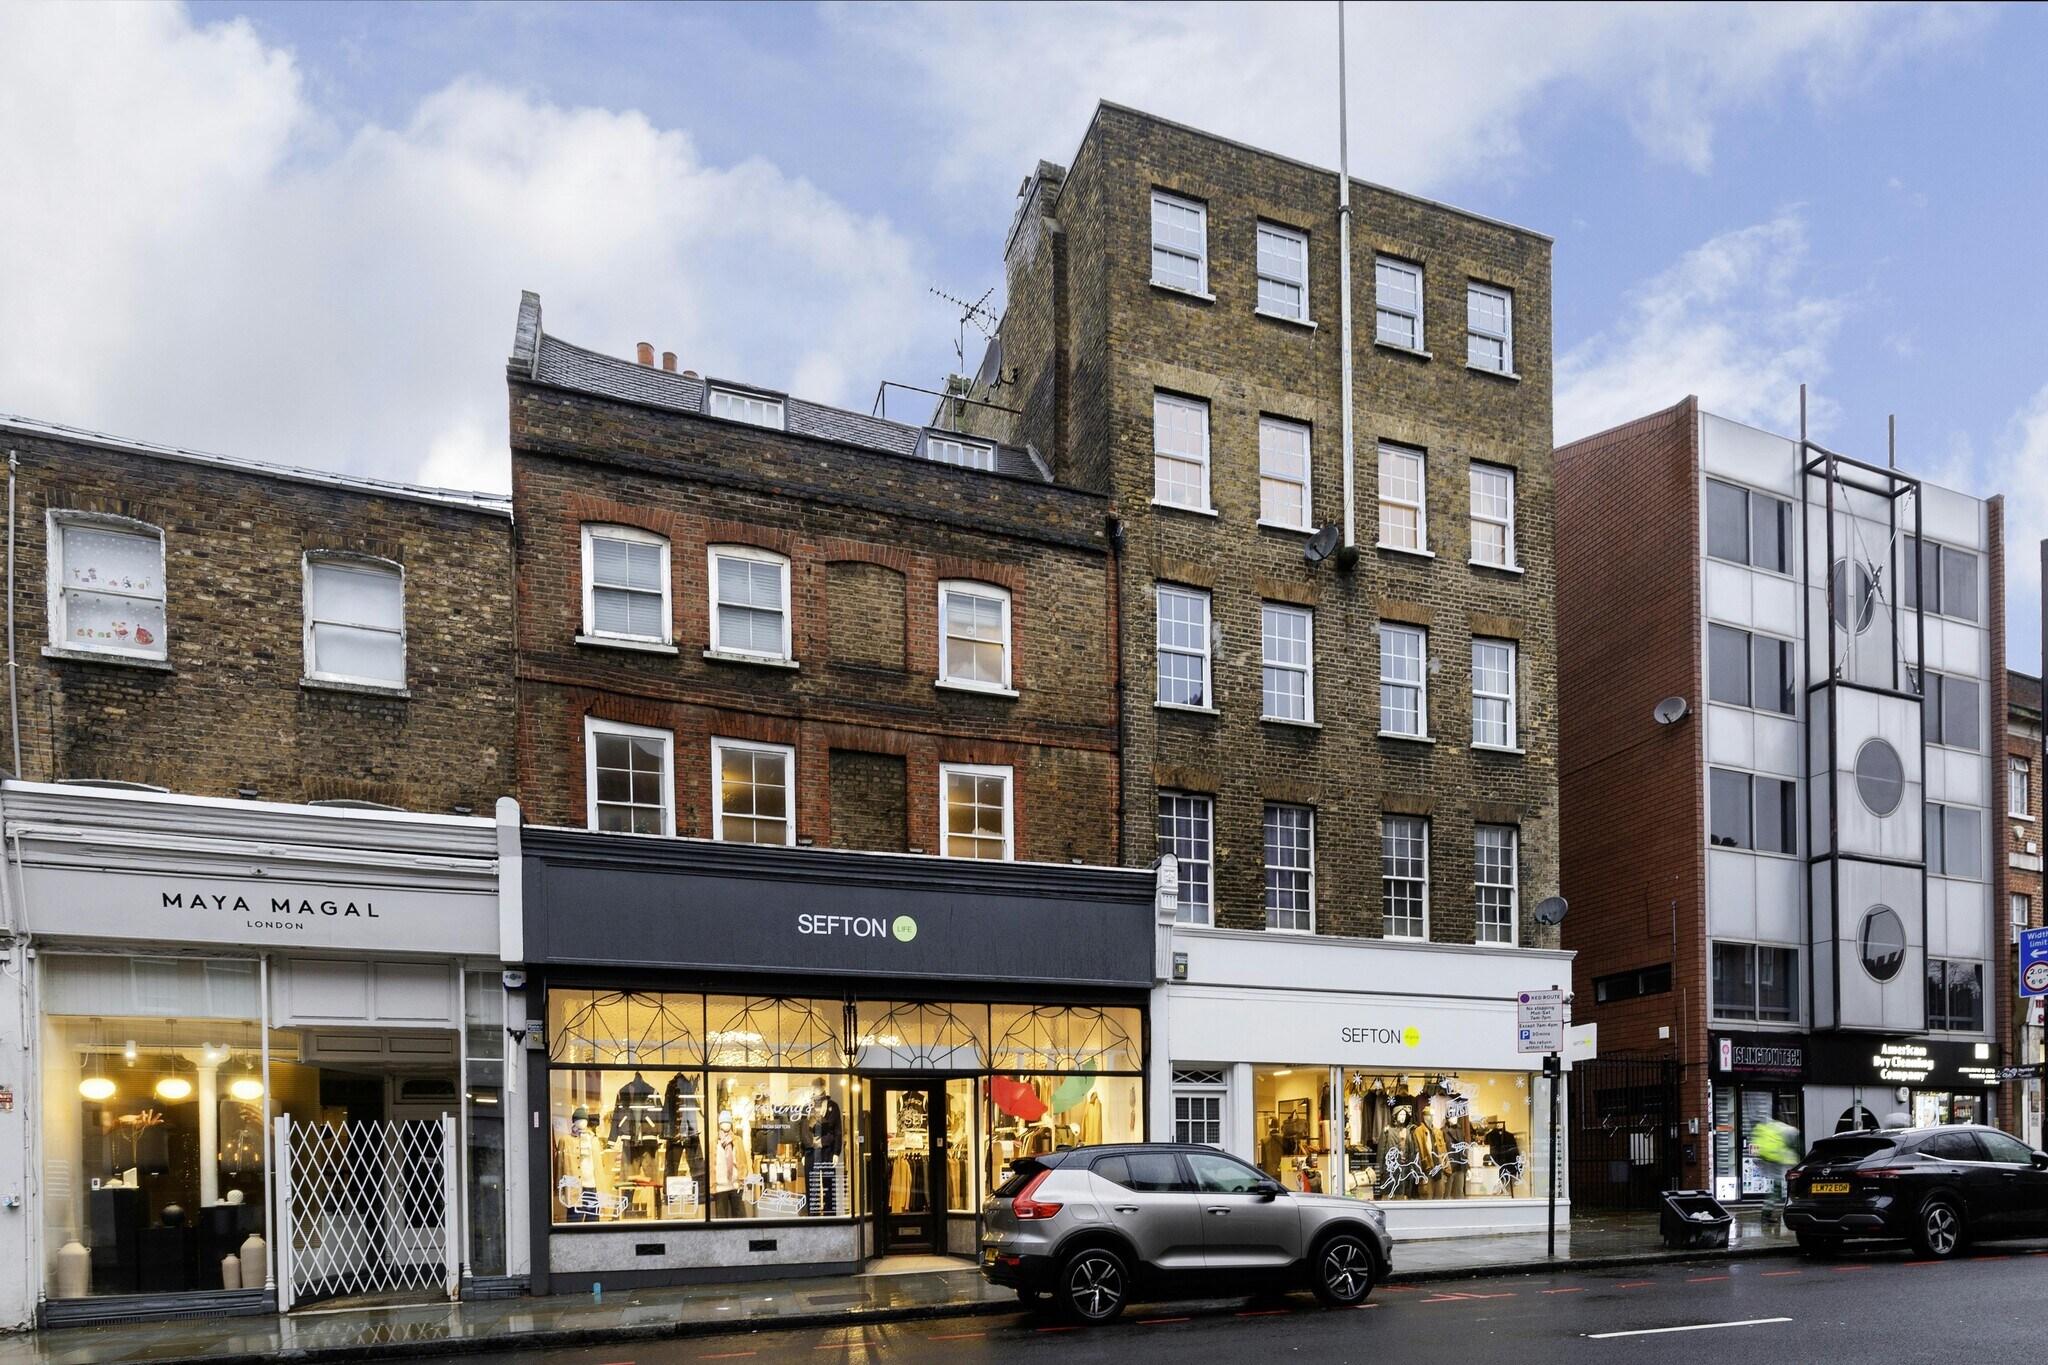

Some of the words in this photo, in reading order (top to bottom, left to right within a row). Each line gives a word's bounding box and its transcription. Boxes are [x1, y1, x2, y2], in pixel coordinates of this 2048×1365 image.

[162, 892, 250, 912] MAYA
[271, 898, 379, 918] MAGAL
[247, 920, 304, 930] LONDON
[797, 913, 887, 938] SEFTON
[897, 925, 913, 933] LIFE
[1341, 1027, 1401, 1044] SEFTON
[1522, 1030, 1529, 1039] P
[1733, 1046, 1779, 1066] ISLINGTON
[1780, 1048, 1802, 1067] TECH
[1881, 1043, 1927, 1056] American
[1873, 1055, 1891, 1068] Dry
[1891, 1056, 1935, 1070] Cleaning
[1880, 1068, 1926, 1082] Company
